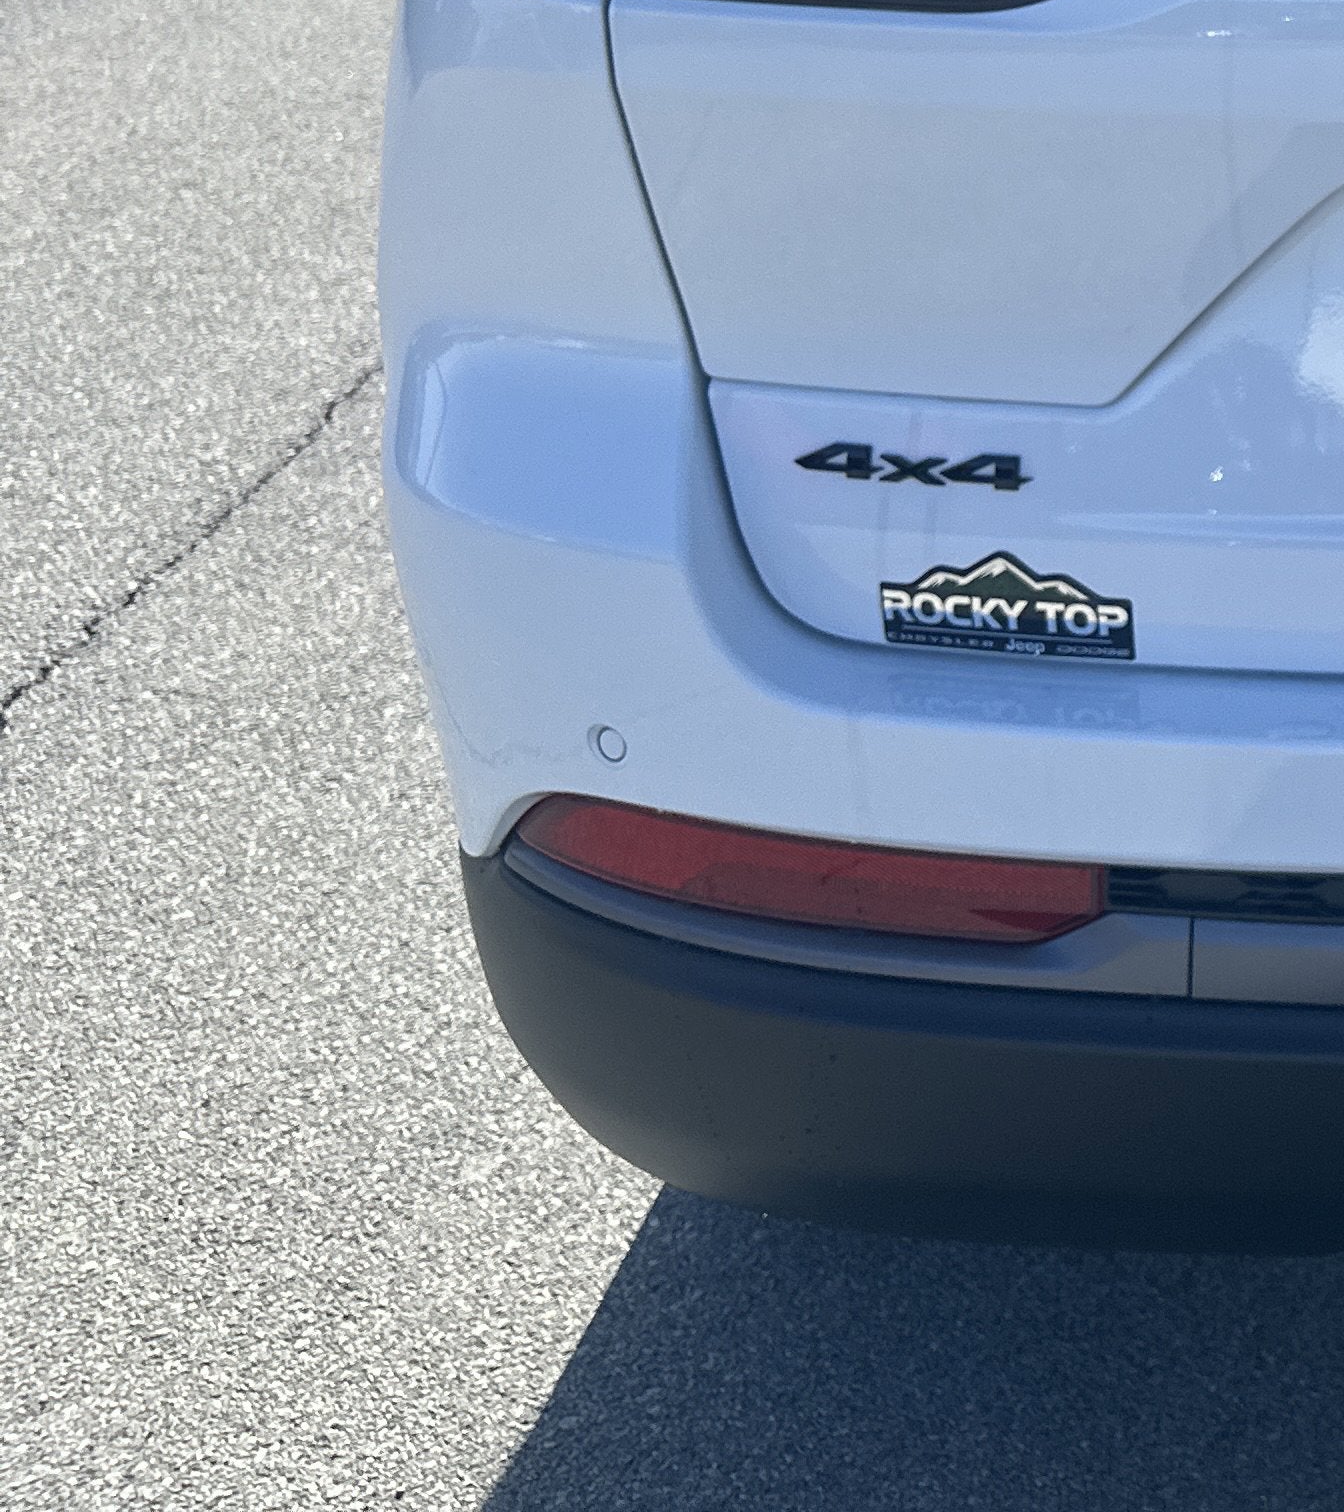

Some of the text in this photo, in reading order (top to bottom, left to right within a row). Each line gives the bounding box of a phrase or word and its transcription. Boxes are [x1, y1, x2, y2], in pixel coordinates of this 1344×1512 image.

[793, 441, 1035, 491] 4x4
[881, 589, 1129, 637] ROCKY TOP
[1005, 637, 1046, 656] Jeep
